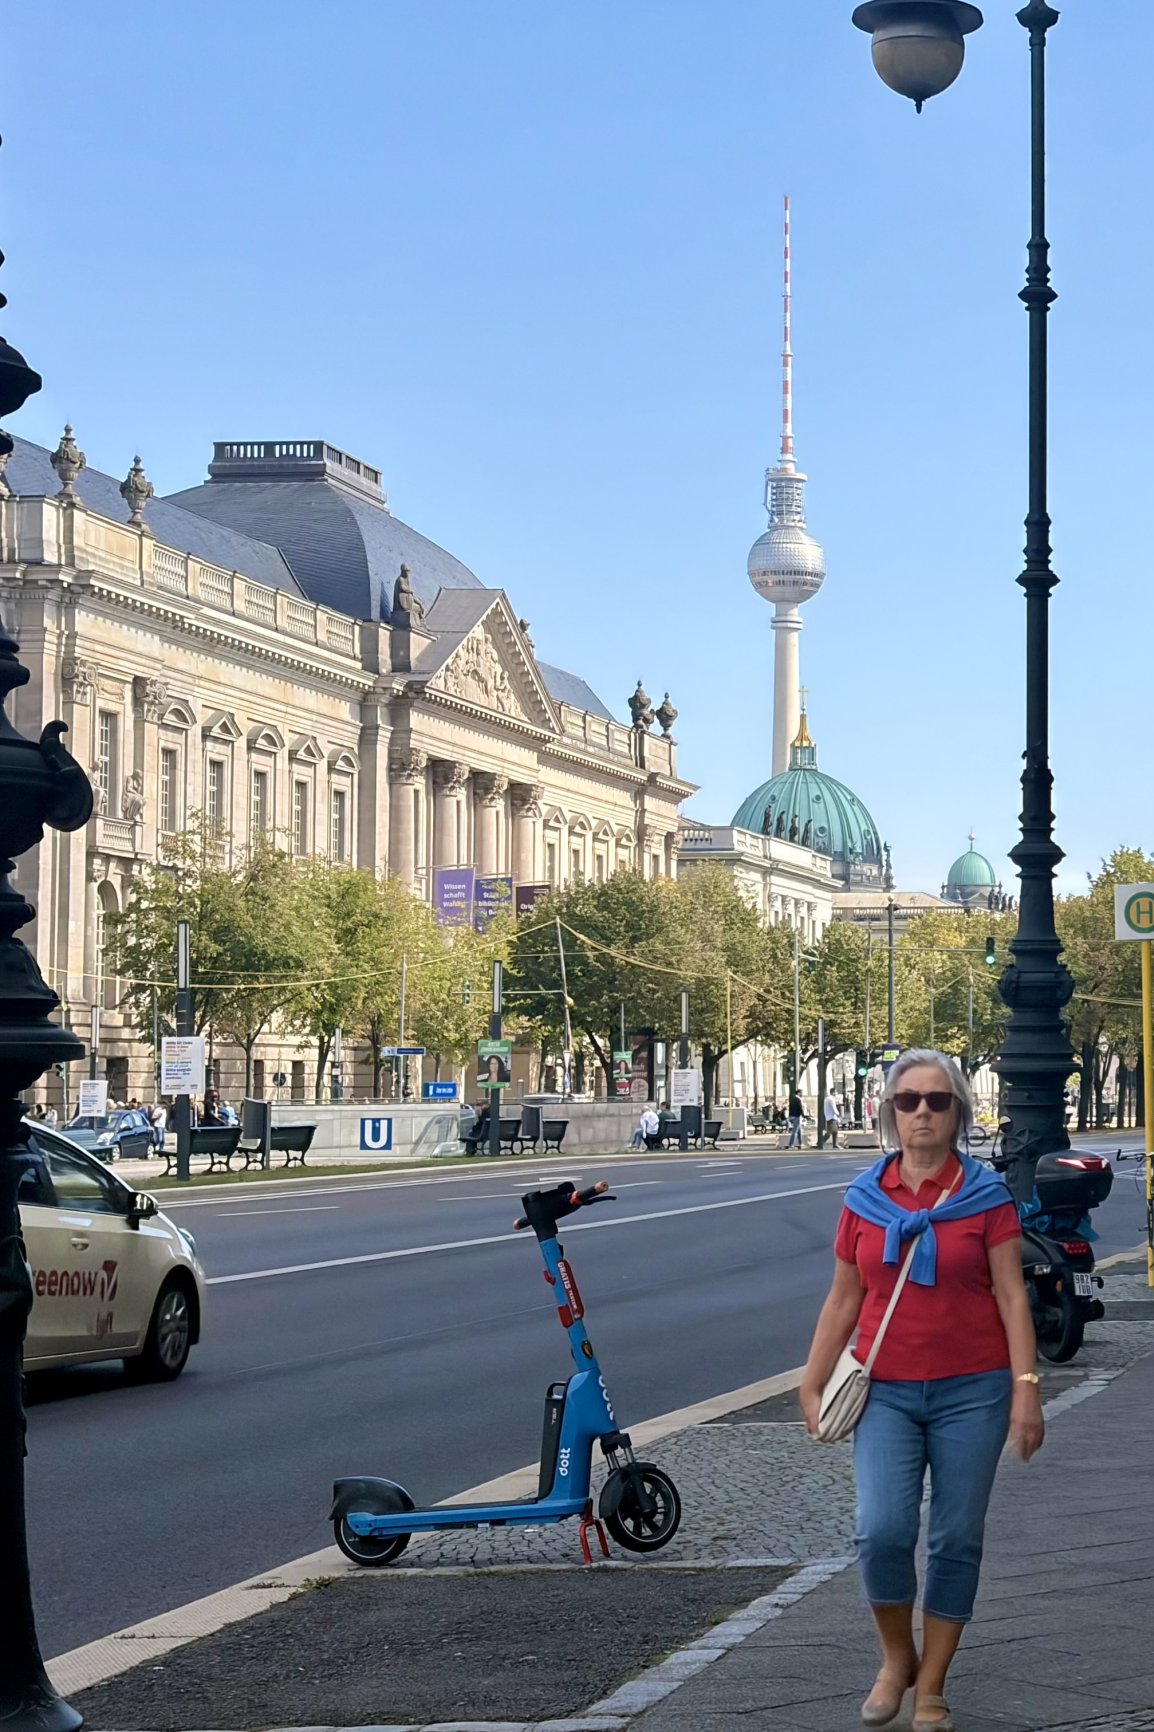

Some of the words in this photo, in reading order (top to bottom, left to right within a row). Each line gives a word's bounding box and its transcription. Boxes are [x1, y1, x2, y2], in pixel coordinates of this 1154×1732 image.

[1136, 901, 1153, 924] H
[364, 1119, 388, 1149] U
[558, 1447, 571, 1477] dott
